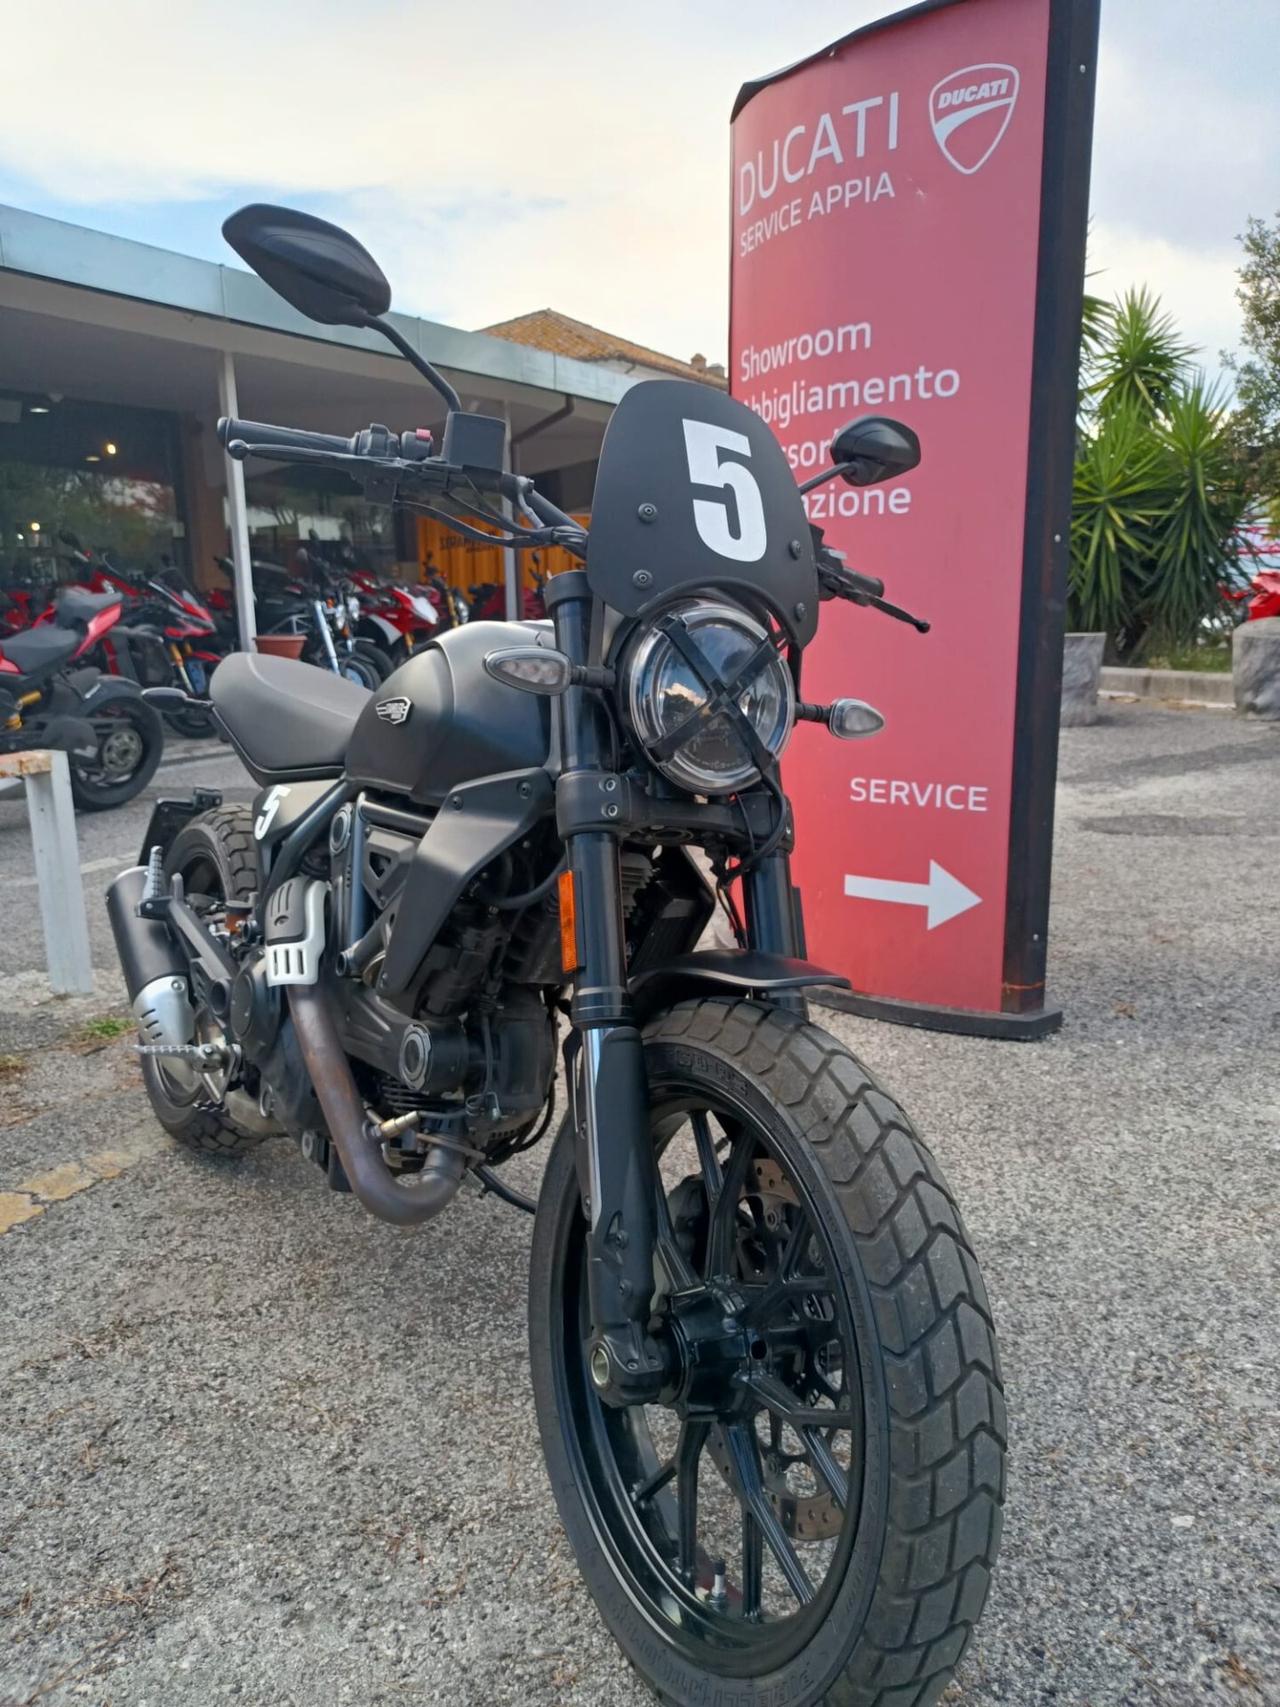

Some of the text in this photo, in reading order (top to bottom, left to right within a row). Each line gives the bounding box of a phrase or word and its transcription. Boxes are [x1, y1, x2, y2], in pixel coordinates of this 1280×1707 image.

[937, 78, 1009, 109] DUCATI
[739, 91, 899, 217] DUCATI
[740, 171, 896, 257] SERVICE APPIA
[740, 320, 872, 382] Showroom
[743, 365, 961, 429] bbigliamento
[682, 418, 768, 563] 5
[254, 784, 291, 841] 5
[849, 776, 989, 812] SERVICE
